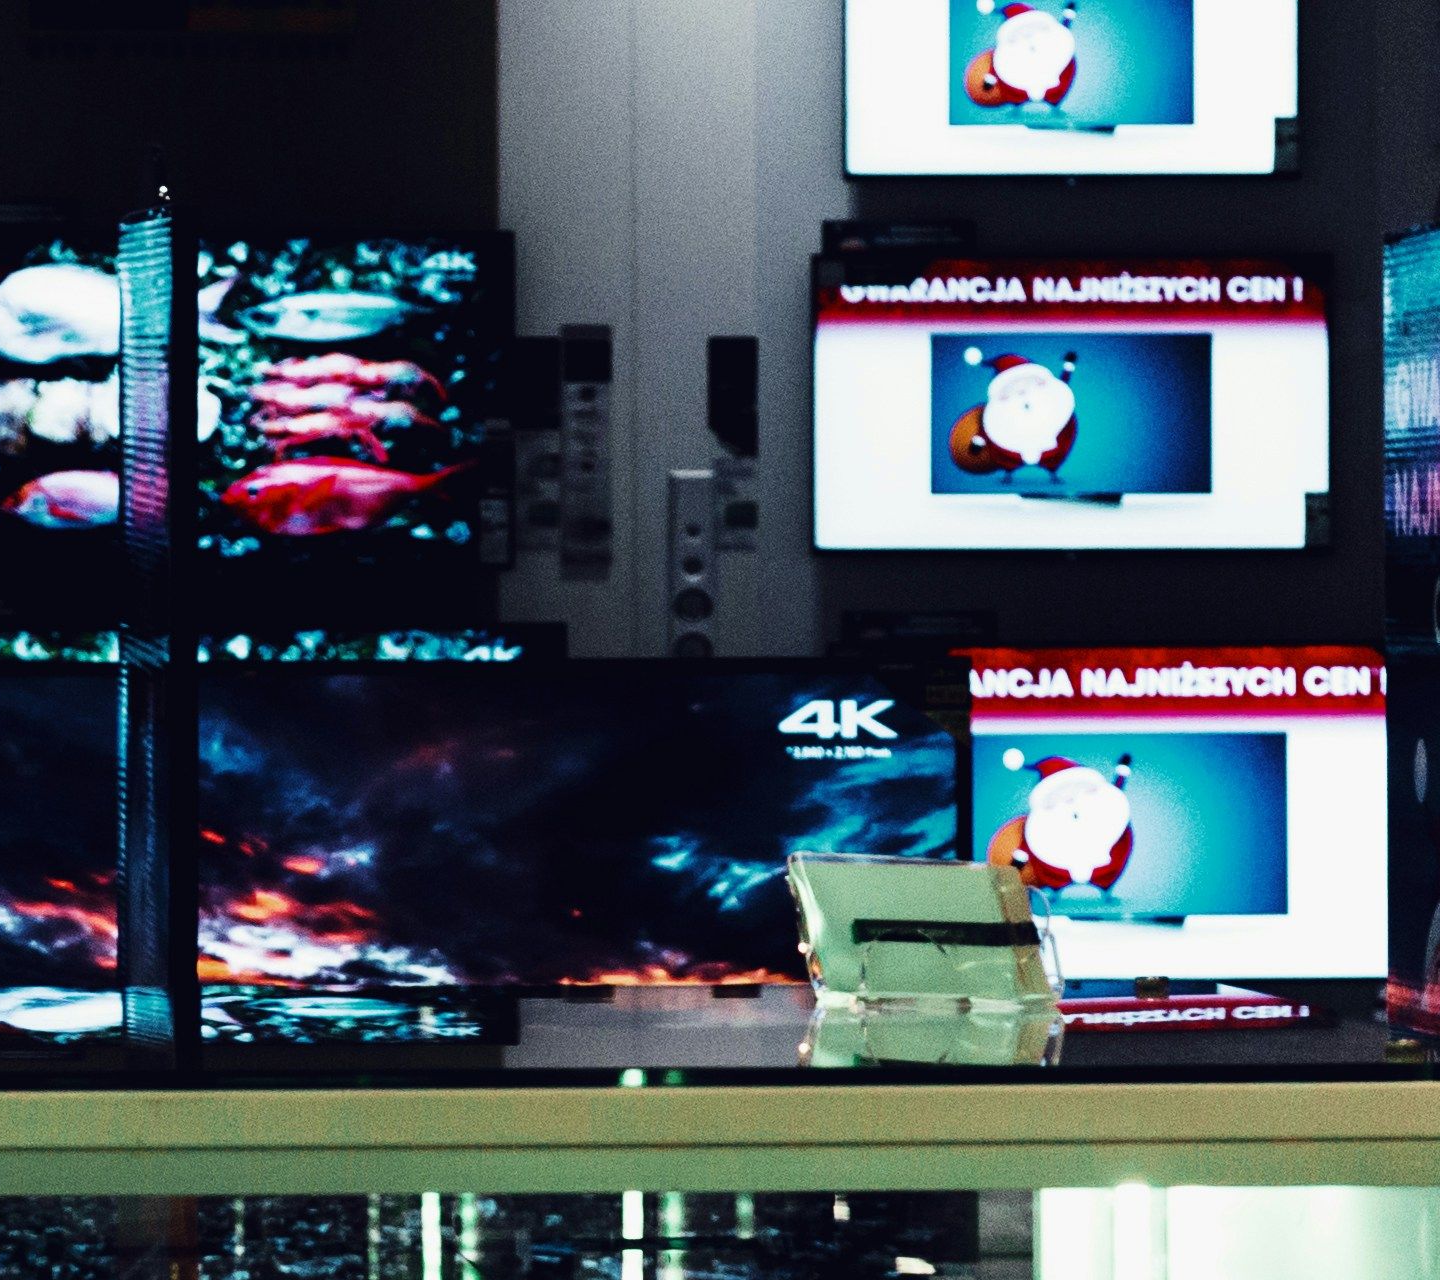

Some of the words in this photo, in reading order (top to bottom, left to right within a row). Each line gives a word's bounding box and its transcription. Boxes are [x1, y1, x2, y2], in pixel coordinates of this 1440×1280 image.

[1227, 276, 1286, 302] CEN
[1303, 666, 1371, 697] CEN
[777, 698, 899, 740] 4K
